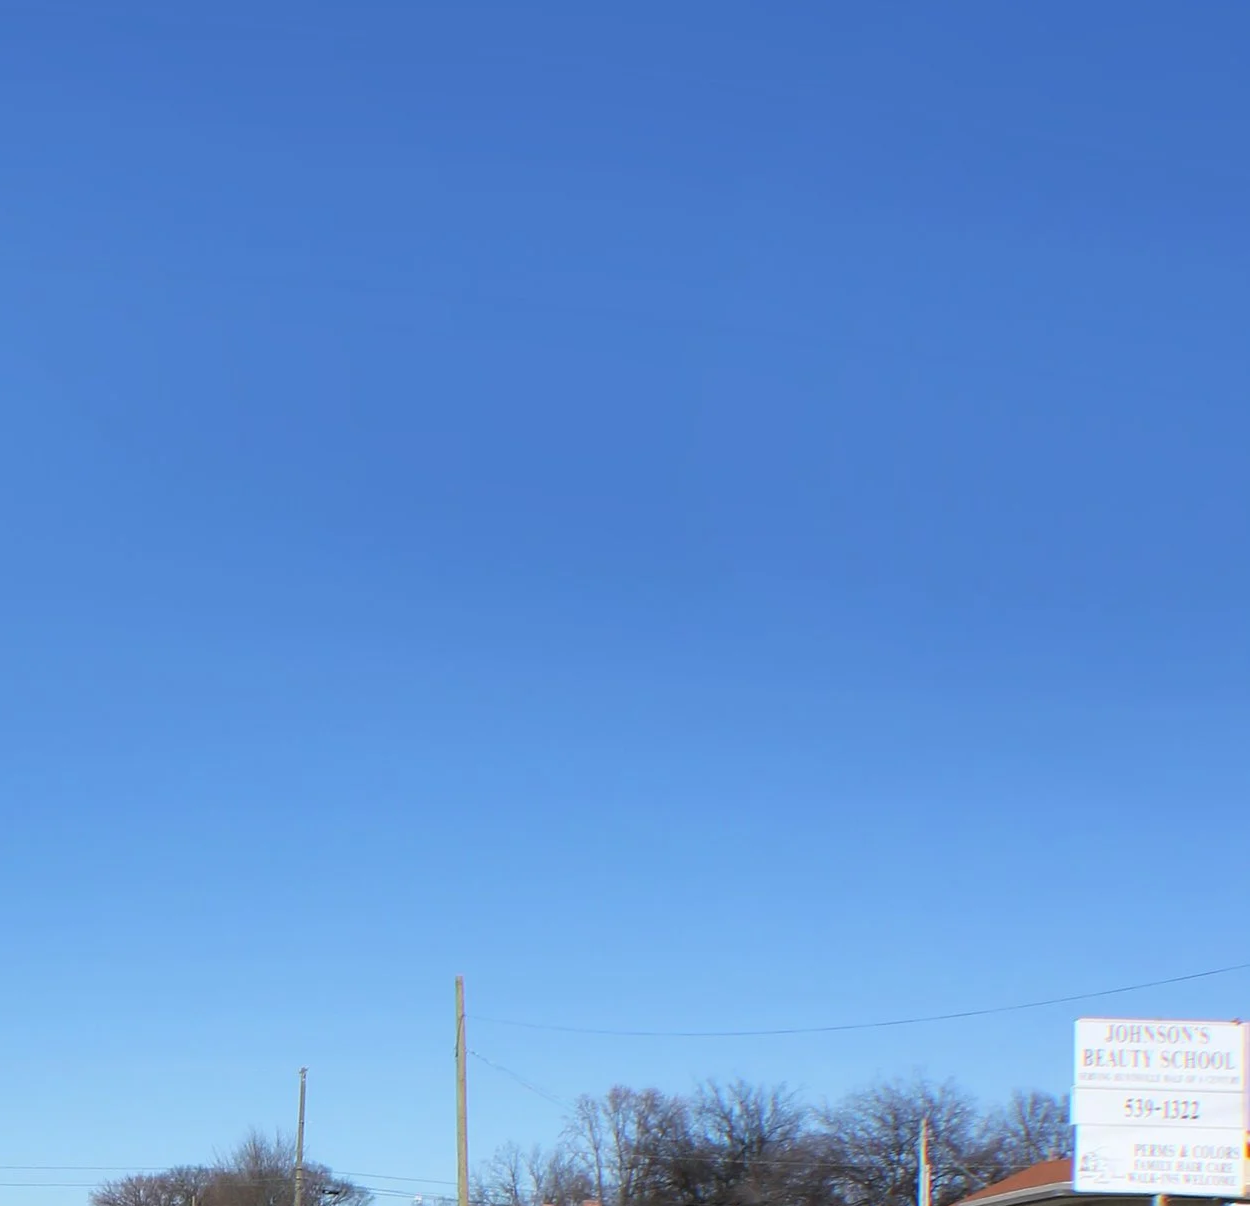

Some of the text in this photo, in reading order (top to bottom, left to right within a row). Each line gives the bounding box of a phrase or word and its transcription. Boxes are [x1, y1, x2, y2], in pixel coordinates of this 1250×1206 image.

[1105, 1024, 1210, 1044] JOHNSON'S
[1082, 1048, 1236, 1070] BEAUTY SCHOOL
[1124, 1098, 1200, 1119] 539-1322
[1134, 1143, 1176, 1157] PERMS
[1193, 1145, 1240, 1159] COLORS
[1205, 1162, 1233, 1173] CARE
